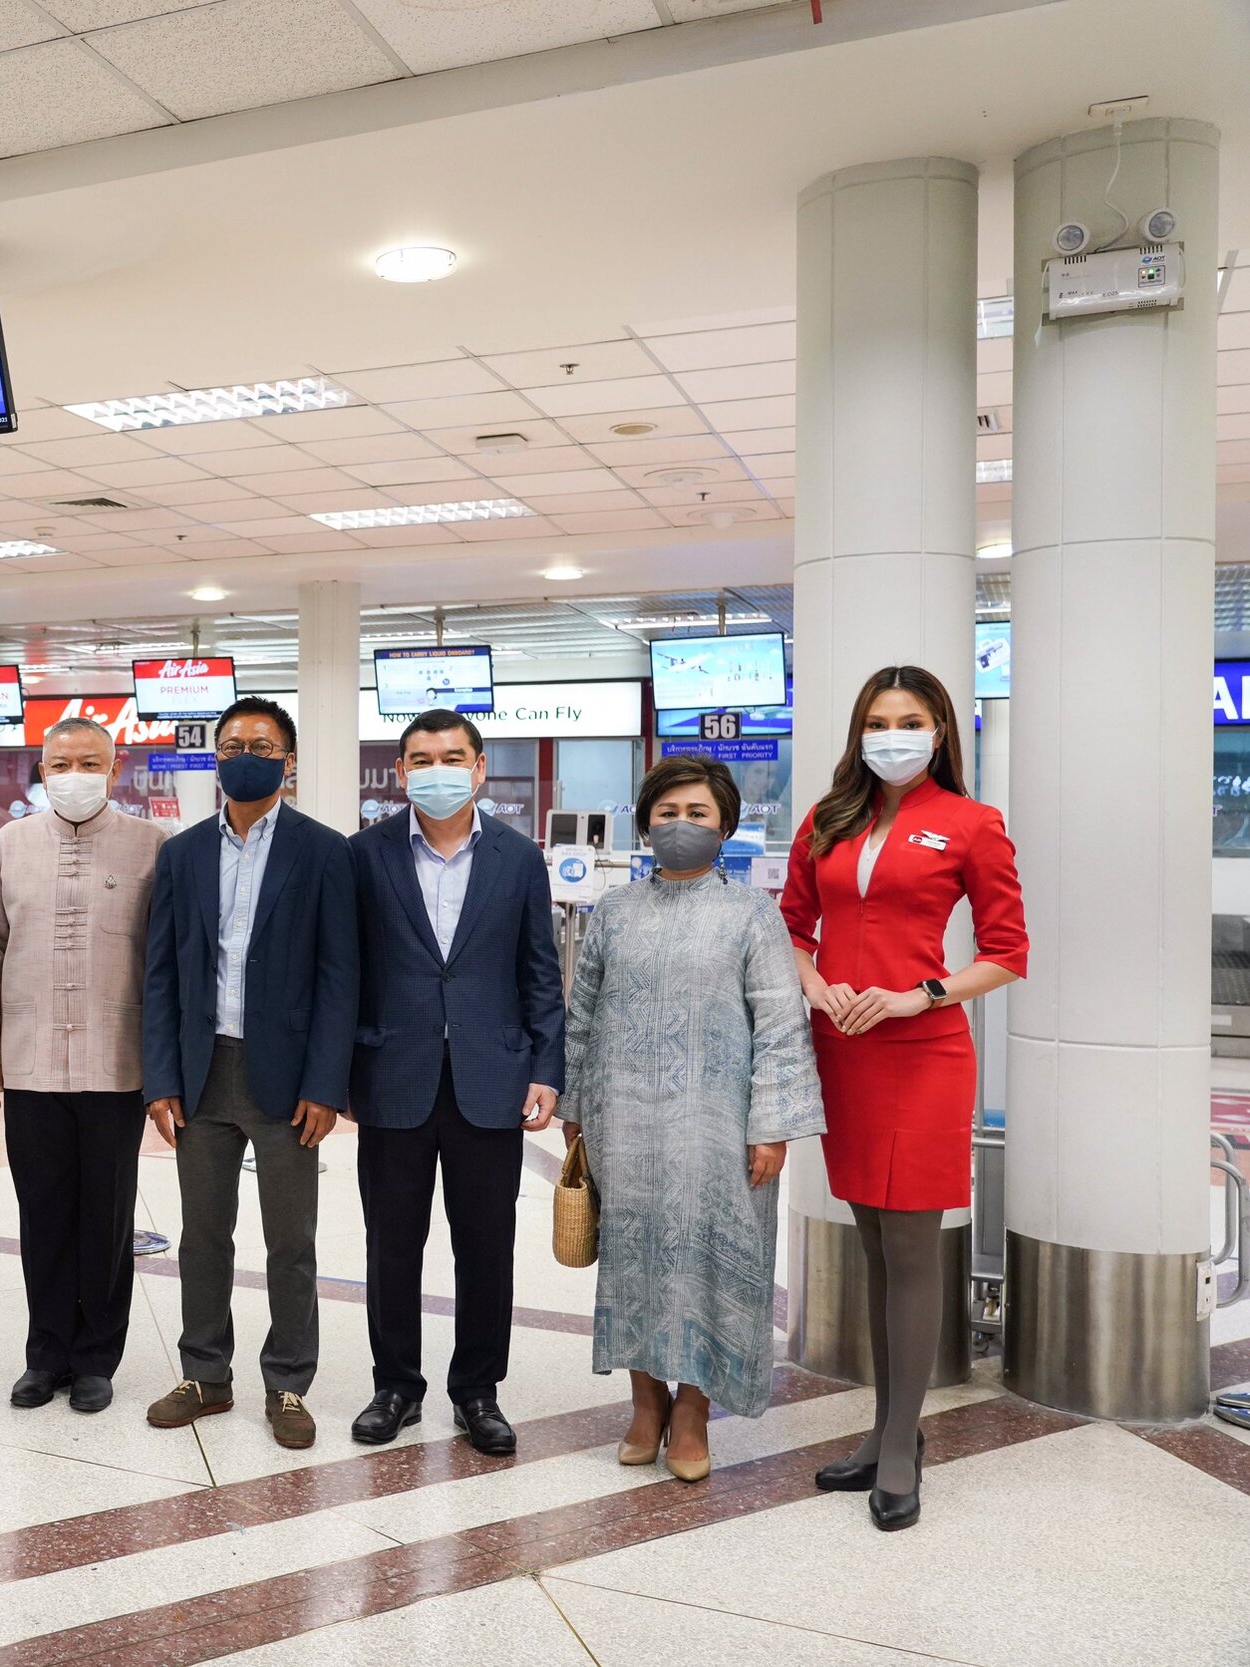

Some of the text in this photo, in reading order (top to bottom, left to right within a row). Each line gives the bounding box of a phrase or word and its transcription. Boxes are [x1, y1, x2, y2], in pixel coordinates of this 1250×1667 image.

[160, 686, 209, 694] PREMIUM
[516, 706, 549, 720] Can
[556, 706, 582, 722] Fly
[704, 714, 737, 739] 56
[178, 726, 202, 747] 54
[497, 804, 524, 814] AOT
[750, 804, 781, 815] AOT
